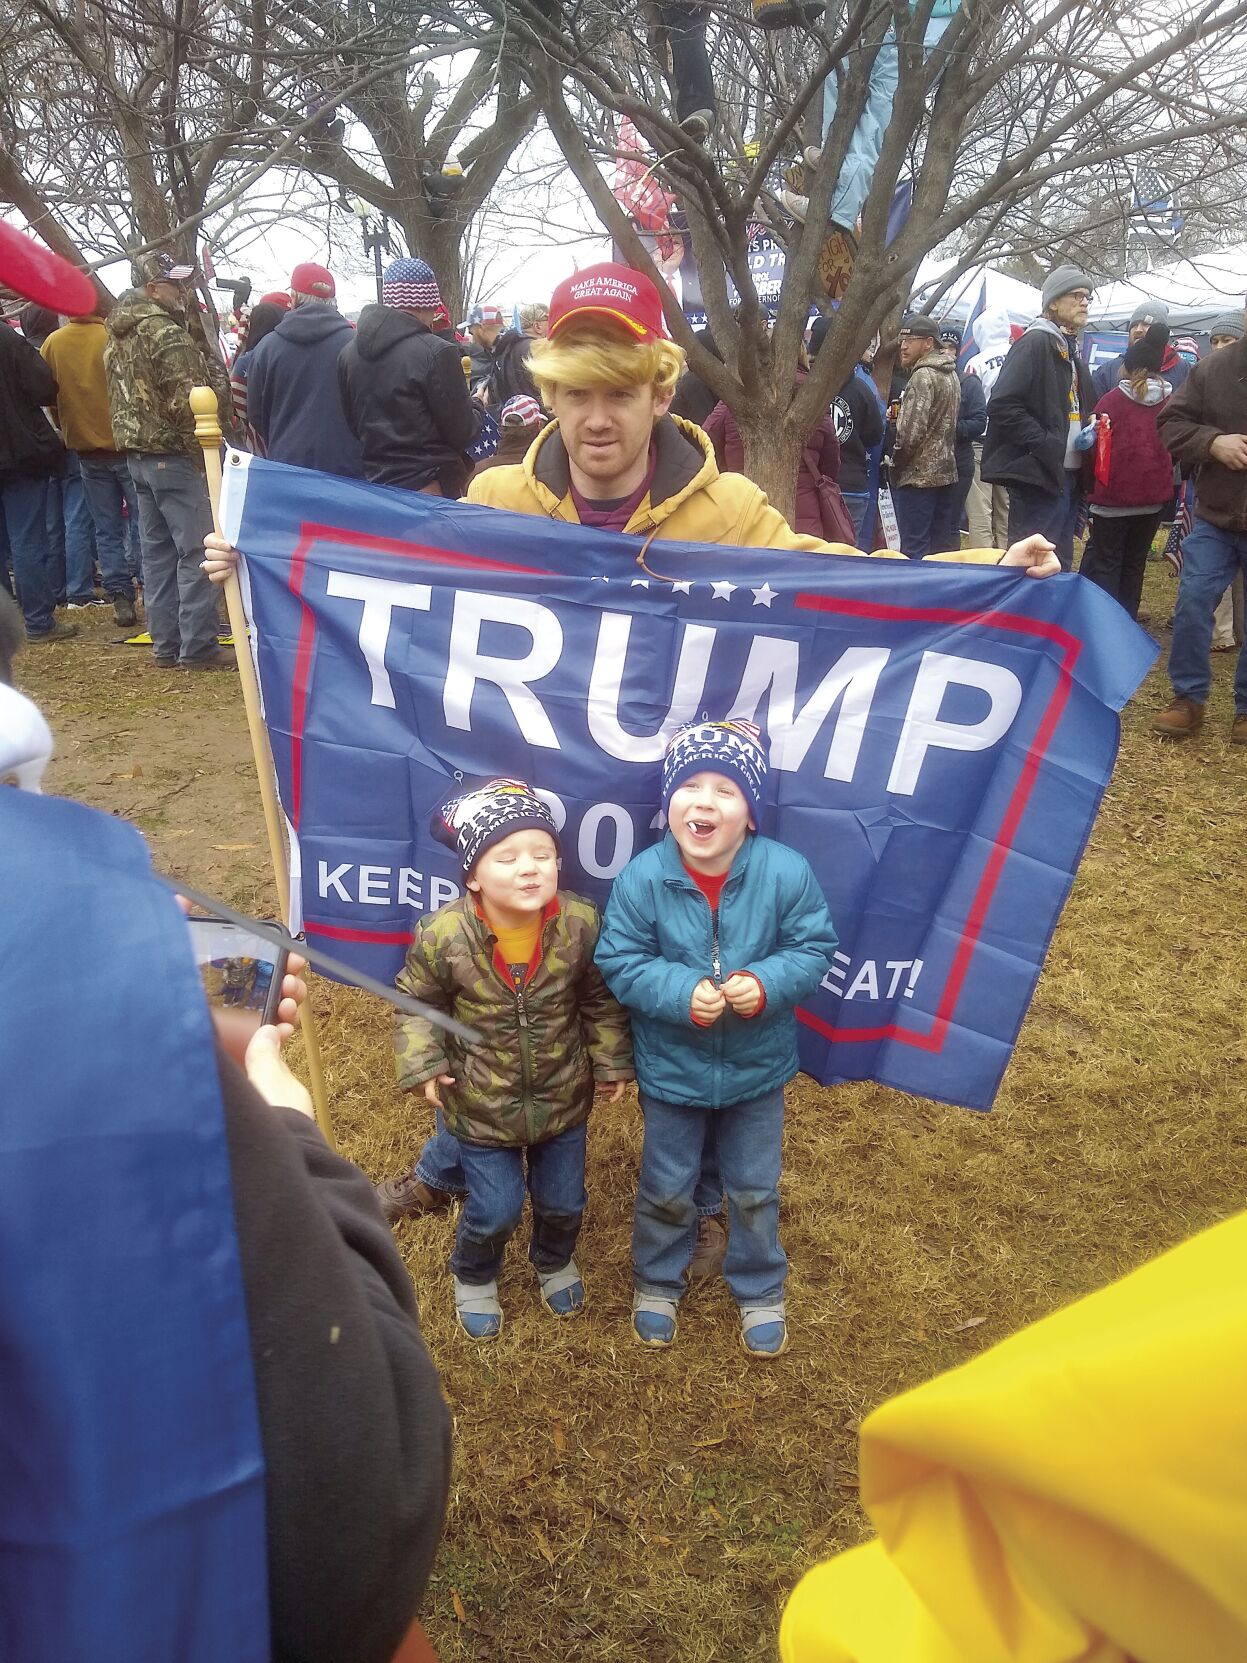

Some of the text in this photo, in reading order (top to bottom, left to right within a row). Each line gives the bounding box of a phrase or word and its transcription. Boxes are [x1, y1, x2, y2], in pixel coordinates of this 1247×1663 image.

[570, 276, 638, 296] MAKE AMERICA
[574, 287, 632, 302] GREAT AGAIN
[758, 294, 780, 303] ERNO
[325, 570, 1024, 796] TRUMP
[676, 752, 739, 772] AMERICA
[318, 860, 460, 912] KEEP
[820, 951, 924, 1000] EAT!
